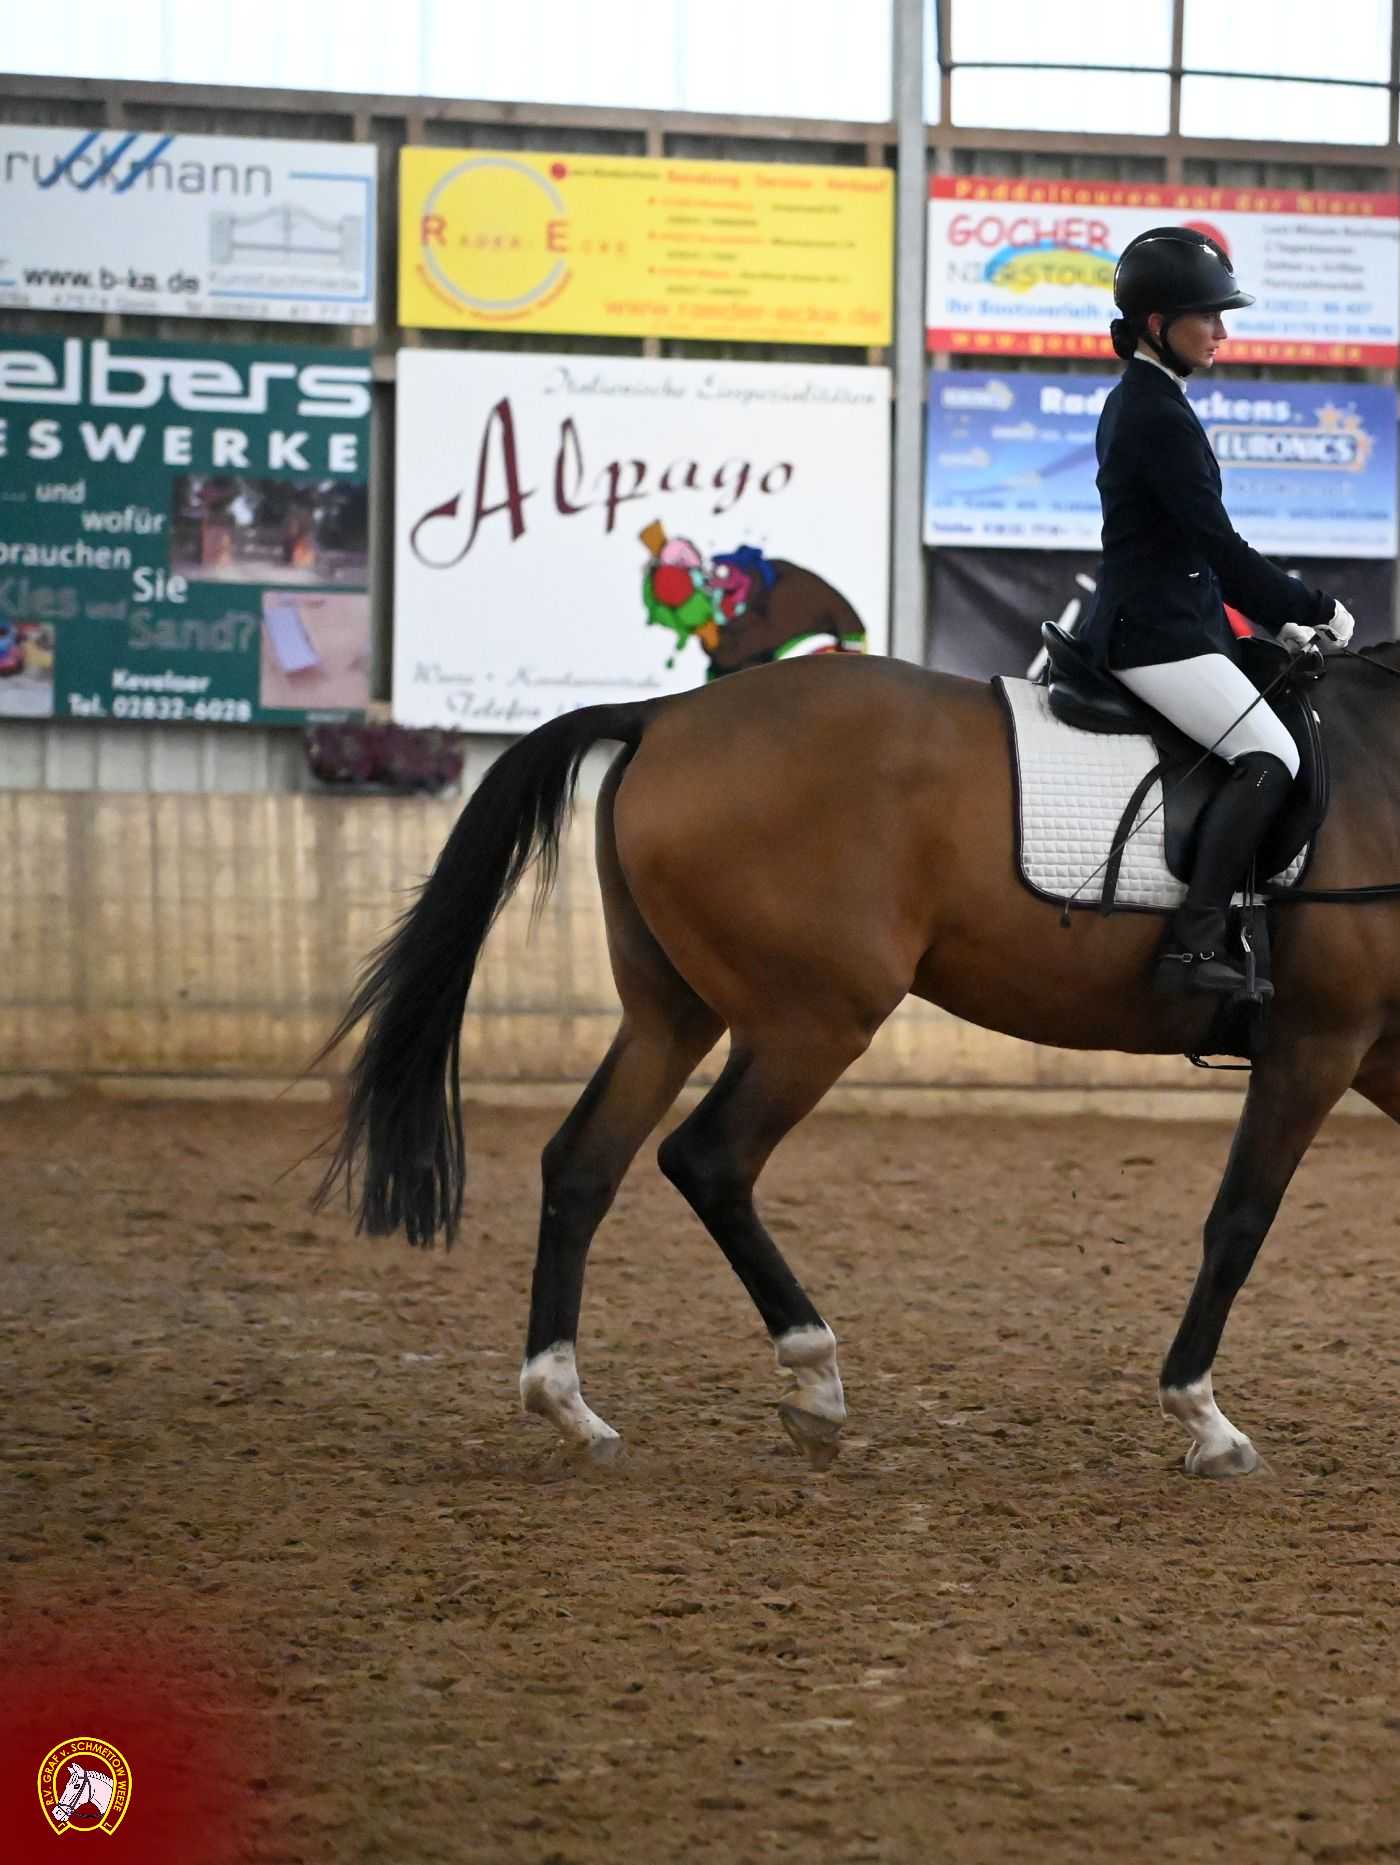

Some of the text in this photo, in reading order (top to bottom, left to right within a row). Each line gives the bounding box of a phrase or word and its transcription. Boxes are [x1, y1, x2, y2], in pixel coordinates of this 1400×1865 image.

[956, 179, 1161, 208] Paddeltouren
[1173, 190, 1222, 211] auf
[1235, 192, 1283, 213] der
[947, 213, 1110, 251] GOCHER
[0, 337, 372, 419] elbers
[1217, 431, 1356, 464] EURONICS
[35, 479, 86, 503] und
[410, 395, 796, 570] Alpago
[80, 505, 166, 535] wofür
[132, 565, 188, 603] Sie
[128, 607, 257, 653] Sand?
[67, 692, 106, 718] Tel.
